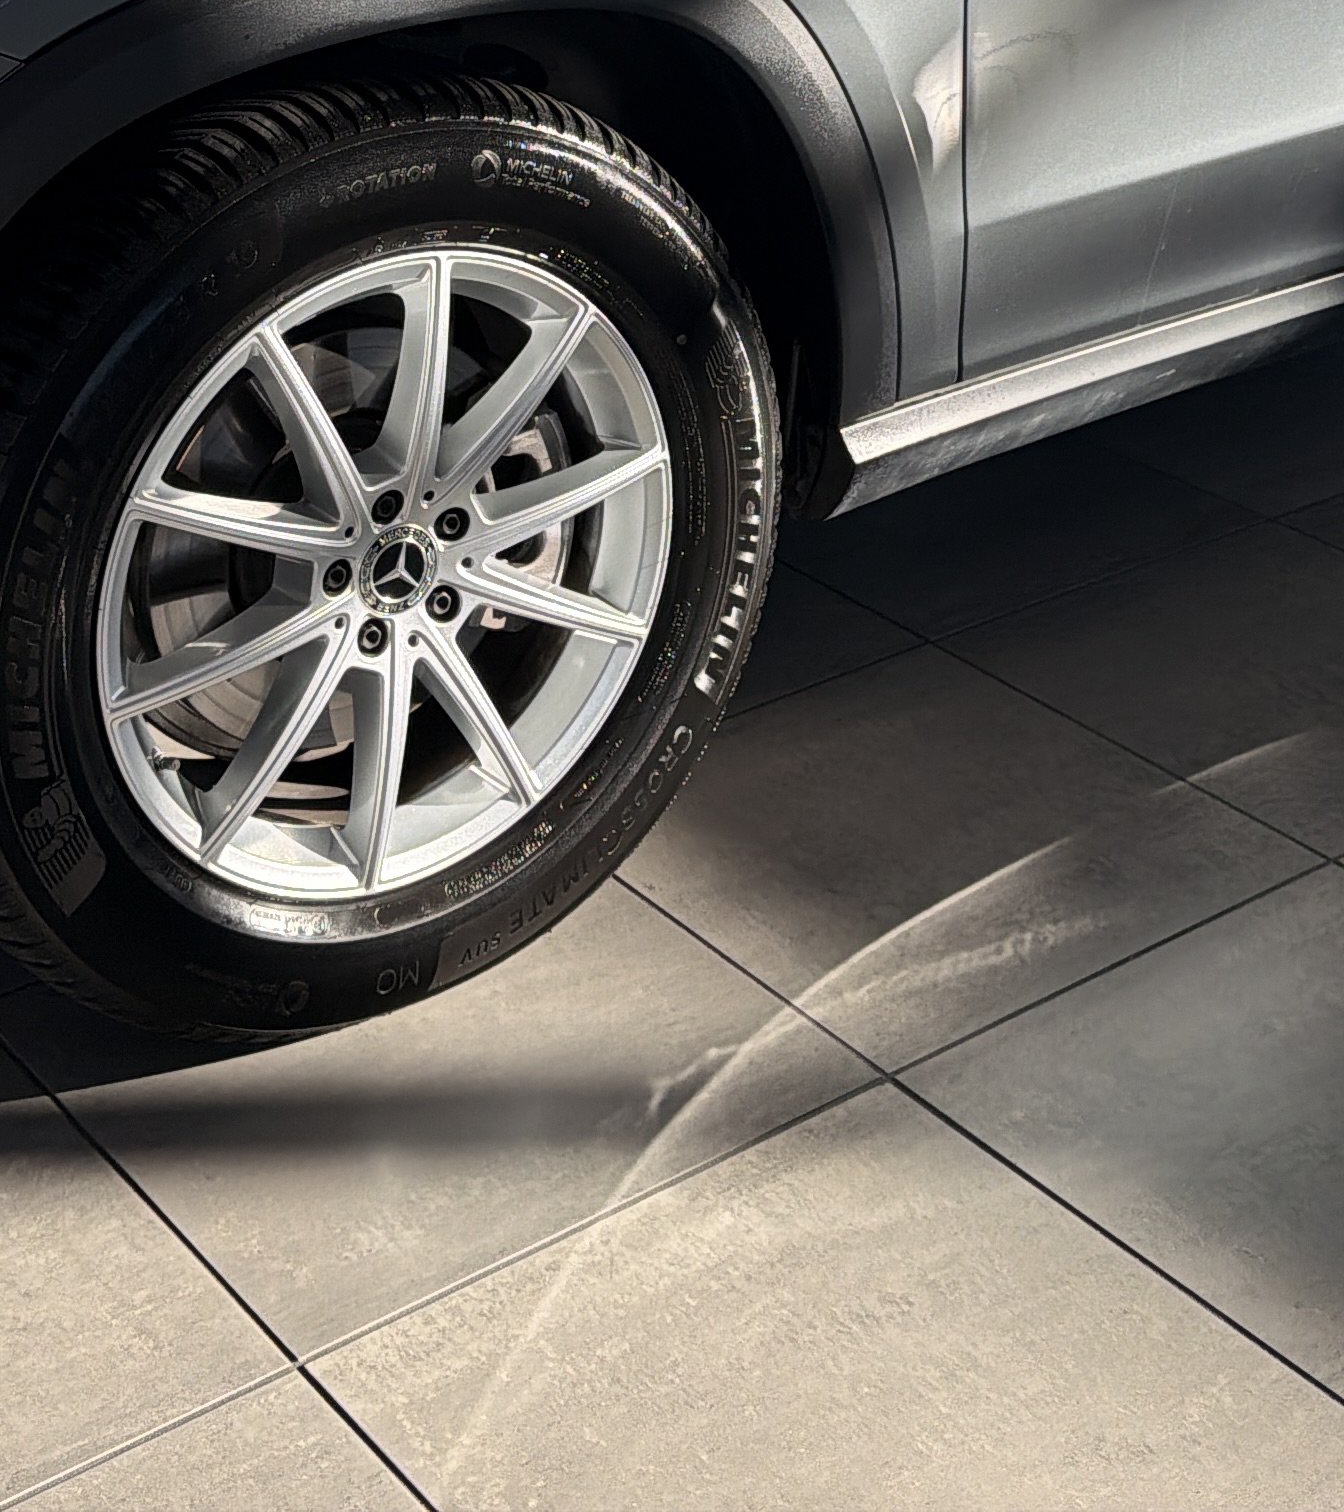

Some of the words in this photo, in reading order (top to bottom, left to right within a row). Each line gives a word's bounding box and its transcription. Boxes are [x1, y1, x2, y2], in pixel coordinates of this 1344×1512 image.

[339, 162, 438, 202] ROTATION
[505, 157, 574, 187] MICHELIN
[692, 416, 762, 706] MICHELIN
[458, 931, 503, 968] SUV
[376, 960, 420, 996] MO
